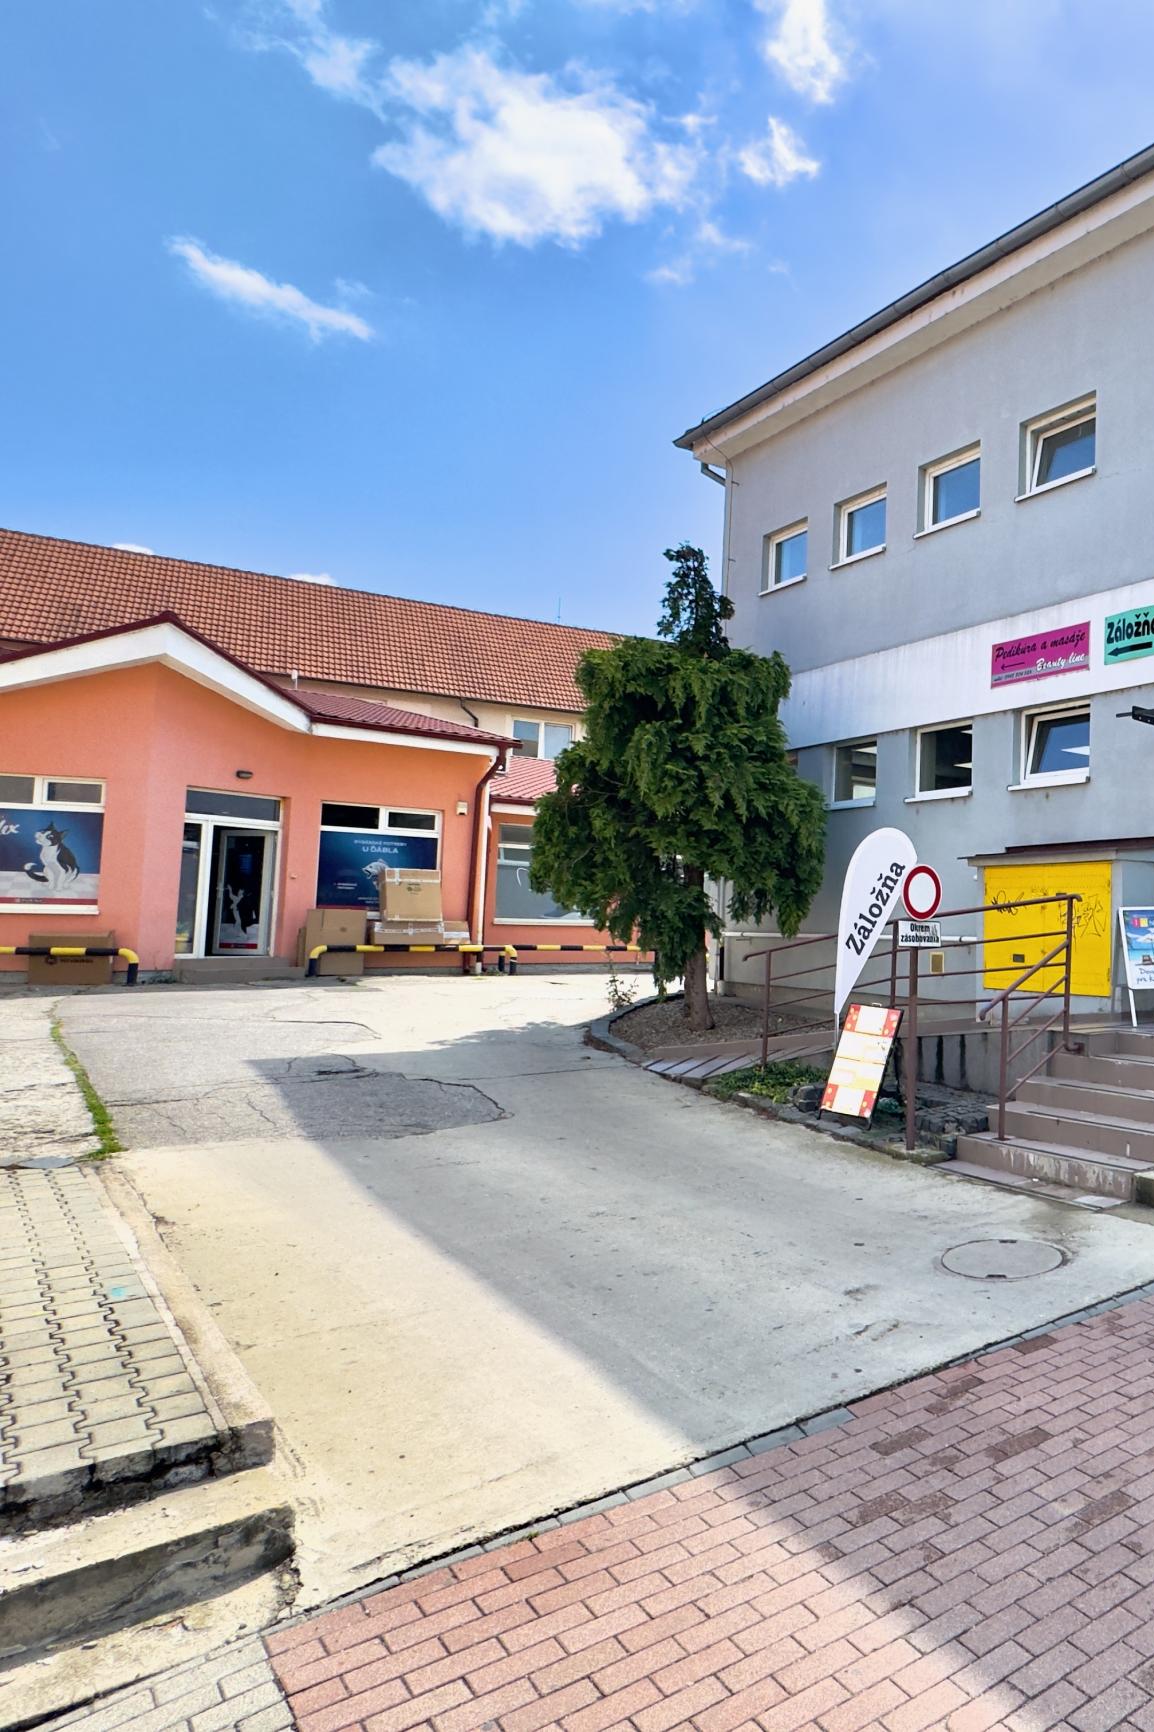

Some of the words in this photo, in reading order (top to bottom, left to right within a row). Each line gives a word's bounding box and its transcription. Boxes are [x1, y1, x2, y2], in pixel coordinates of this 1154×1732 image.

[1036, 657, 1066, 671] Beauty
[1068, 652, 1085, 664] line
[845, 862, 906, 956] Záložňa
[910, 922, 930, 932] Okrem
